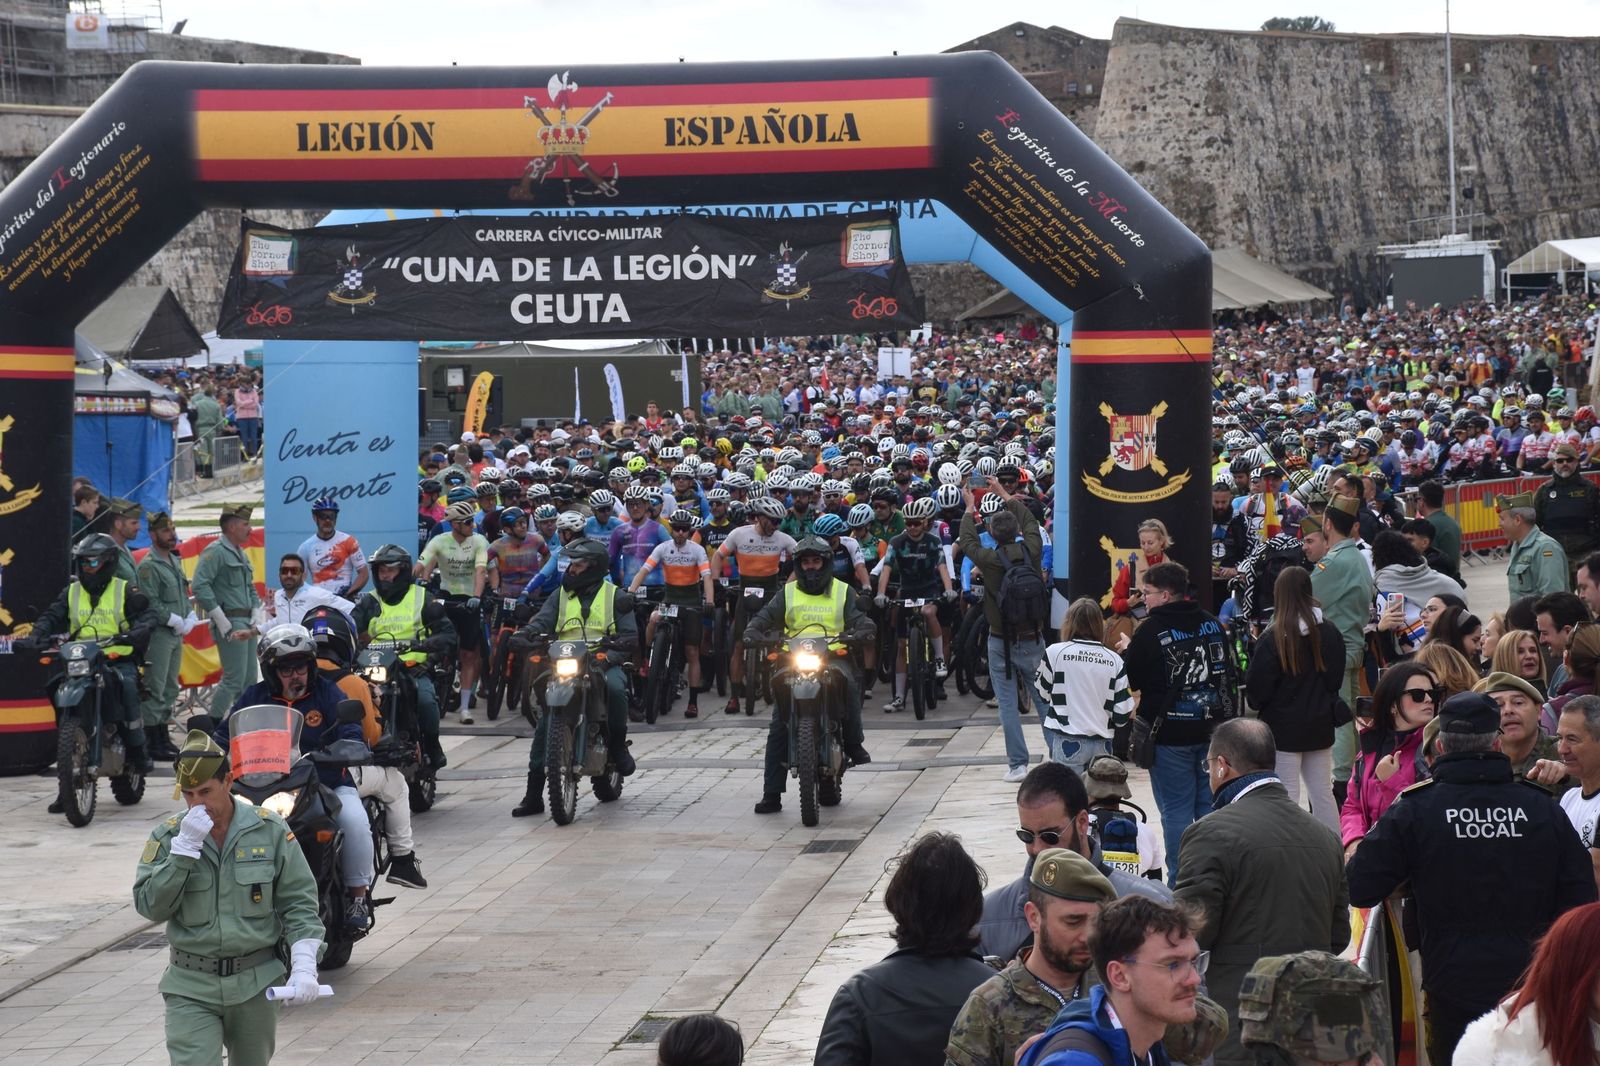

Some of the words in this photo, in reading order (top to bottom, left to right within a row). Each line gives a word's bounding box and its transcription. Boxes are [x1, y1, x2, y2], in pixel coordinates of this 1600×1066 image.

[296, 114, 435, 152] LEGIÓN
[664, 107, 861, 146] ESPAÑOLA
[36, 179, 55, 208] del
[52, 122, 126, 190] Legionario
[994, 107, 1056, 168] Espíritu
[1056, 166, 1076, 182] de
[1072, 180, 1090, 196] la
[1088, 191, 1145, 248] Muerte
[978, 128, 997, 144] El
[990, 144, 1014, 164] morir
[1012, 164, 1024, 174] en
[1030, 180, 1062, 208] combate
[1078, 222, 1104, 245] mayor
[476, 229, 544, 242] CARRERA
[548, 226, 662, 242] CÍVICO-MILITAR
[852, 232, 872, 242] The
[252, 240, 270, 250] The
[852, 242, 888, 251] Corner
[252, 250, 287, 260] Corner
[852, 251, 878, 260] Shop
[251, 260, 277, 270] Shop
[512, 258, 550, 282] DE
[563, 256, 602, 281] LA
[510, 293, 631, 324] CEUTA
[278, 428, 360, 462] Ceuta
[368, 433, 395, 451] es
[282, 472, 396, 504] Deporte
[802, 614, 824, 622] CIVIL
[1094, 658, 1114, 666] SANTO
[1446, 808, 1528, 824] POLICIA
[1455, 822, 1523, 838] LOCAL
[1116, 862, 1139, 875] 5281
